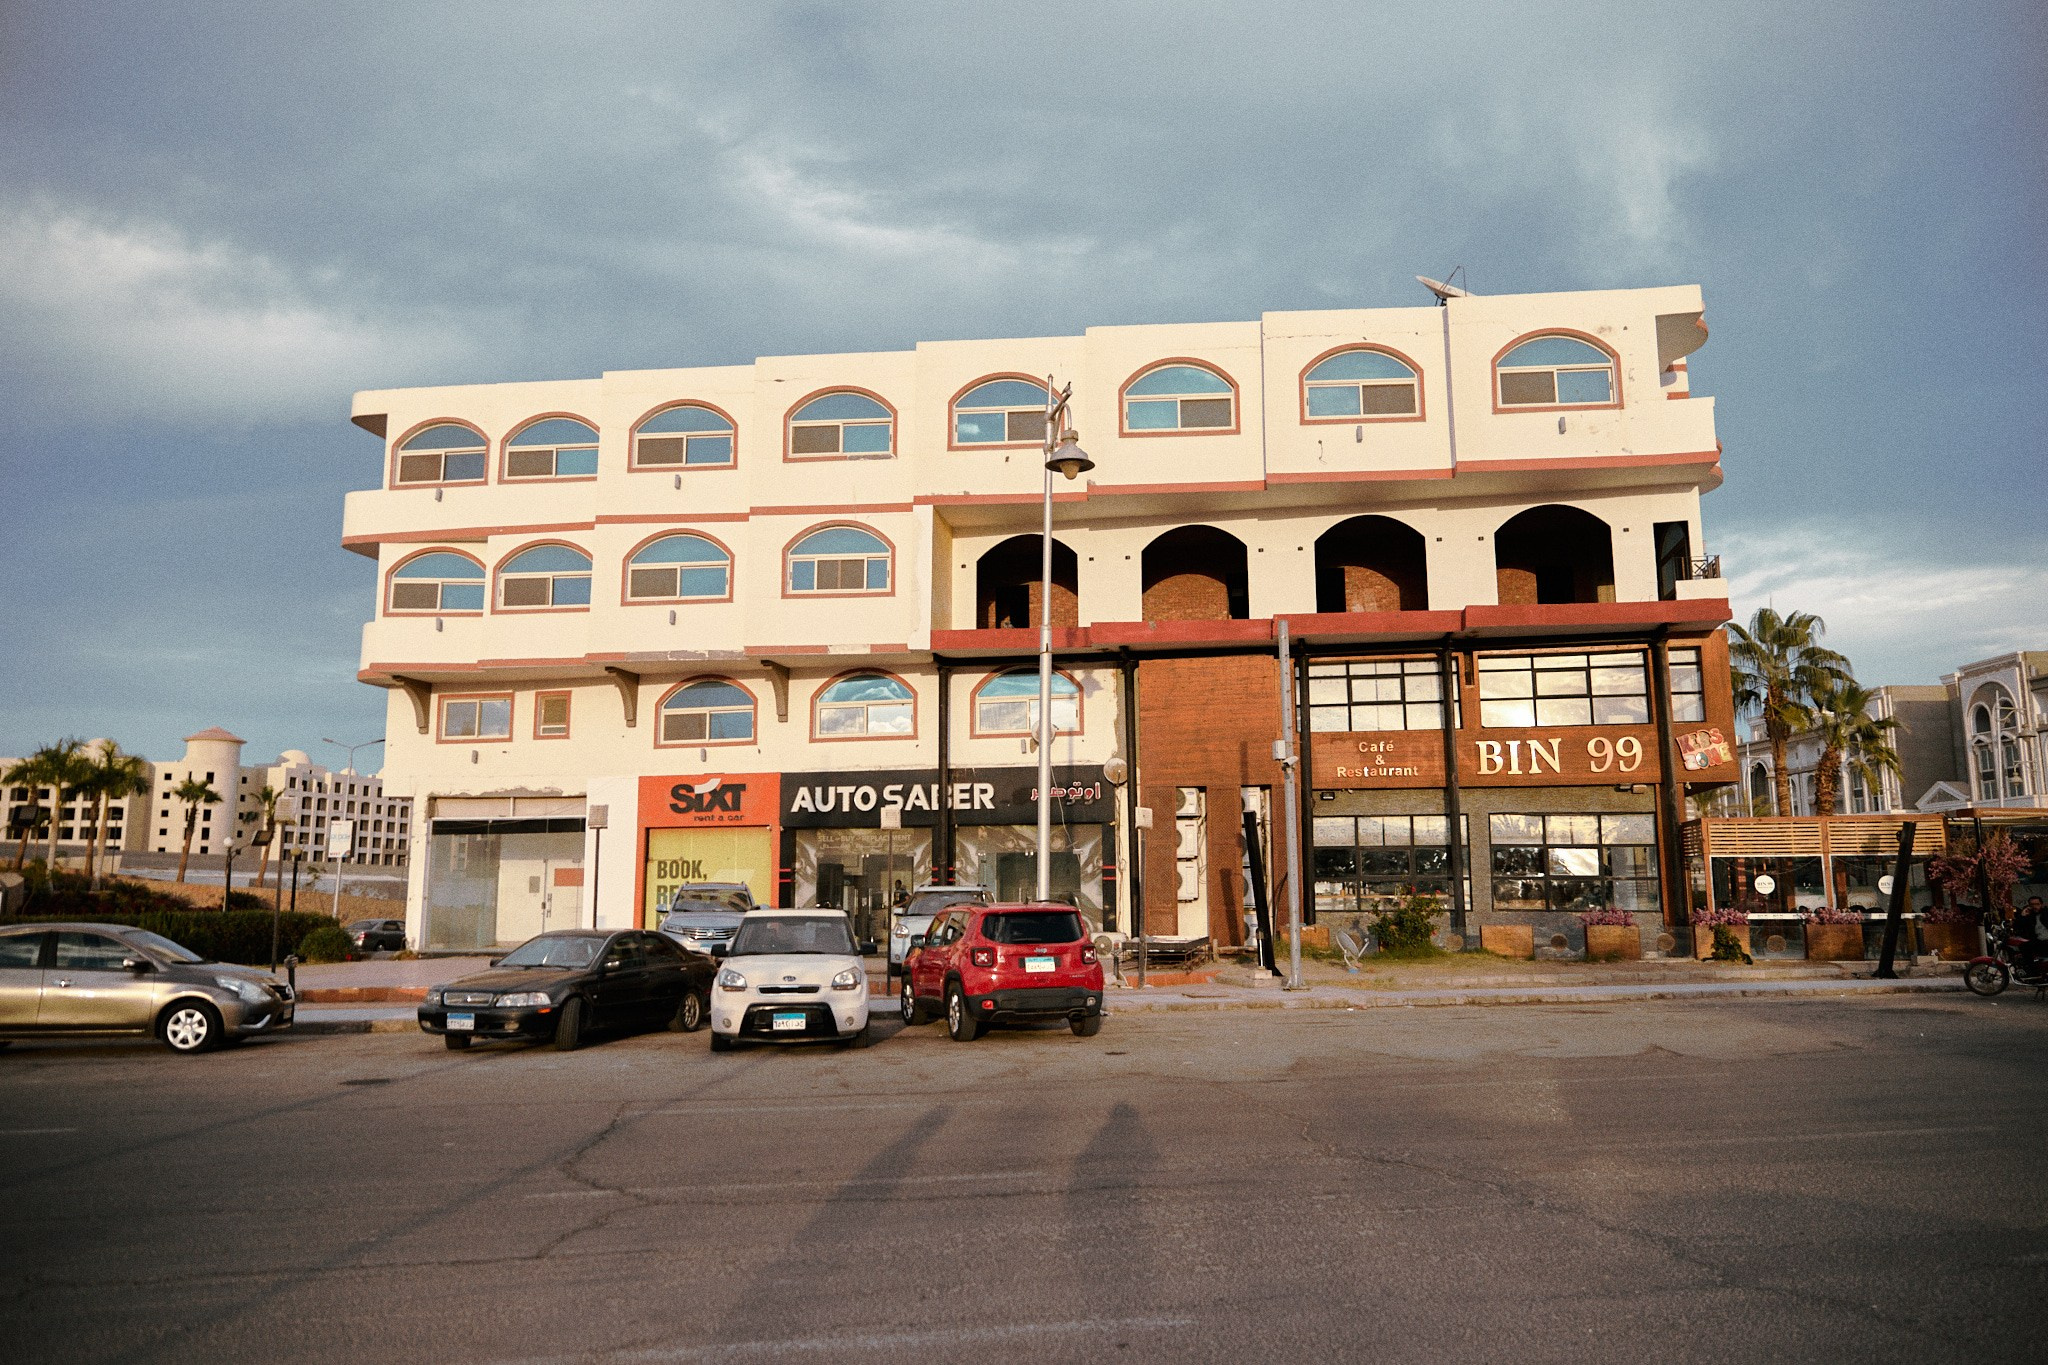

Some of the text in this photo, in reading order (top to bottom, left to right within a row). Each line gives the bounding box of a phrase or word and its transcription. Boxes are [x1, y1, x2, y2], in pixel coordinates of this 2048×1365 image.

[1358, 740, 1394, 752] Café
[1675, 728, 1724, 754] KIDS
[1375, 754, 1385, 766] &
[1475, 736, 1643, 775] BIN 99
[1683, 742, 1733, 770] ZONE
[1336, 765, 1419, 778] Restaurant
[790, 785, 878, 813] AUTO
[694, 814, 715, 822] rent
[657, 859, 707, 880] BOOK,
